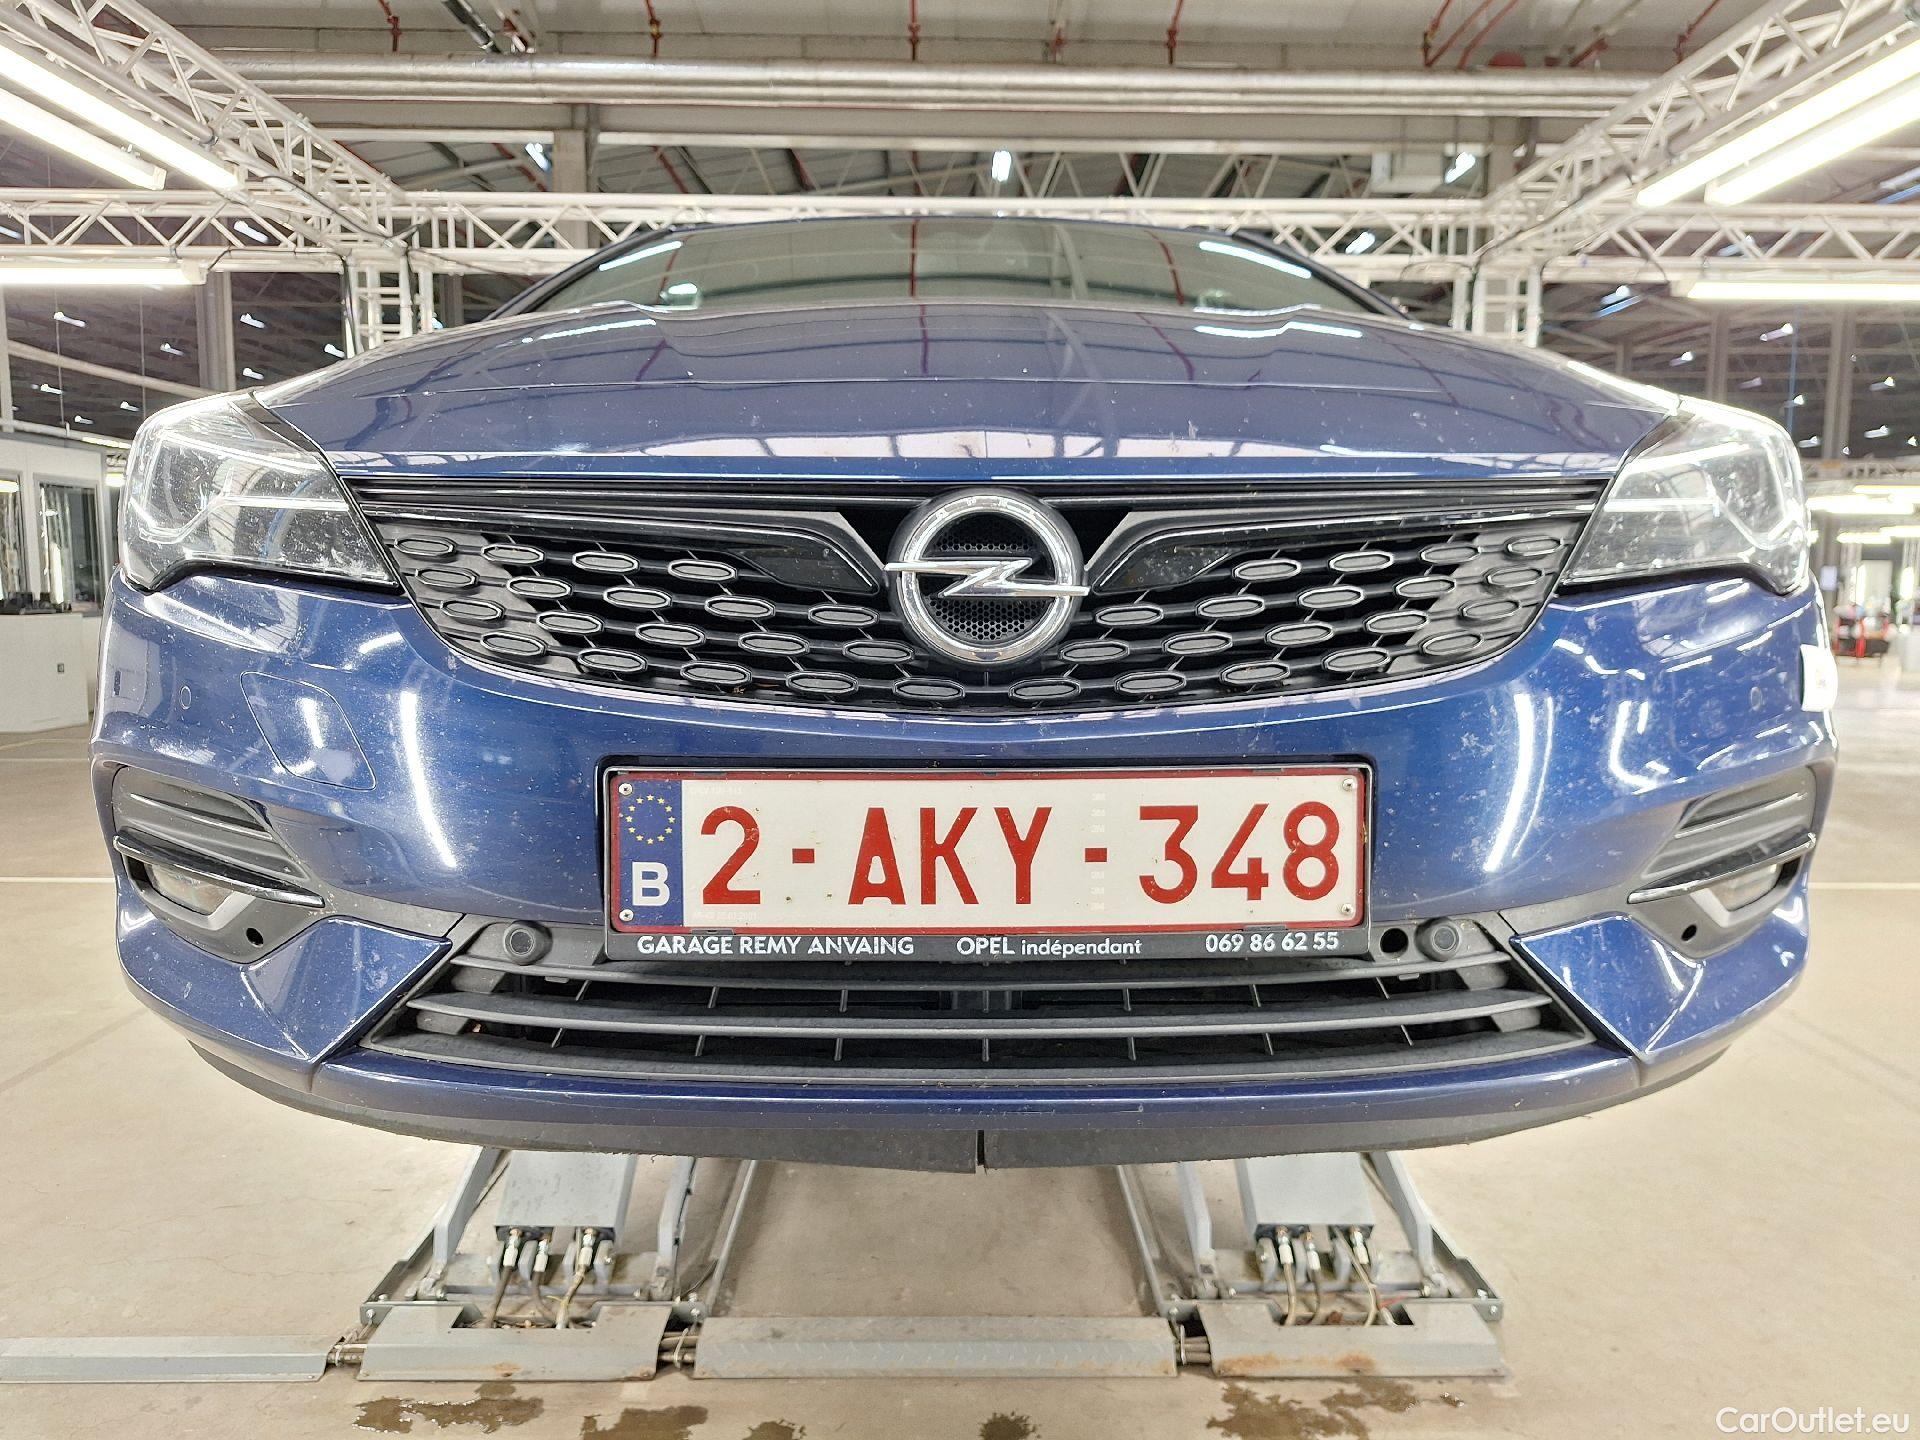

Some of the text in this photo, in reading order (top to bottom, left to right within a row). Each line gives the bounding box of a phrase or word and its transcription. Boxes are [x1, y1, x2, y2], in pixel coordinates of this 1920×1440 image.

[631, 861, 670, 906] B
[637, 935, 914, 955] GARAGE REMY ANVAING
[956, 936, 1142, 958] OPEL indépendant
[1205, 931, 1339, 953] 069 86 62 55
